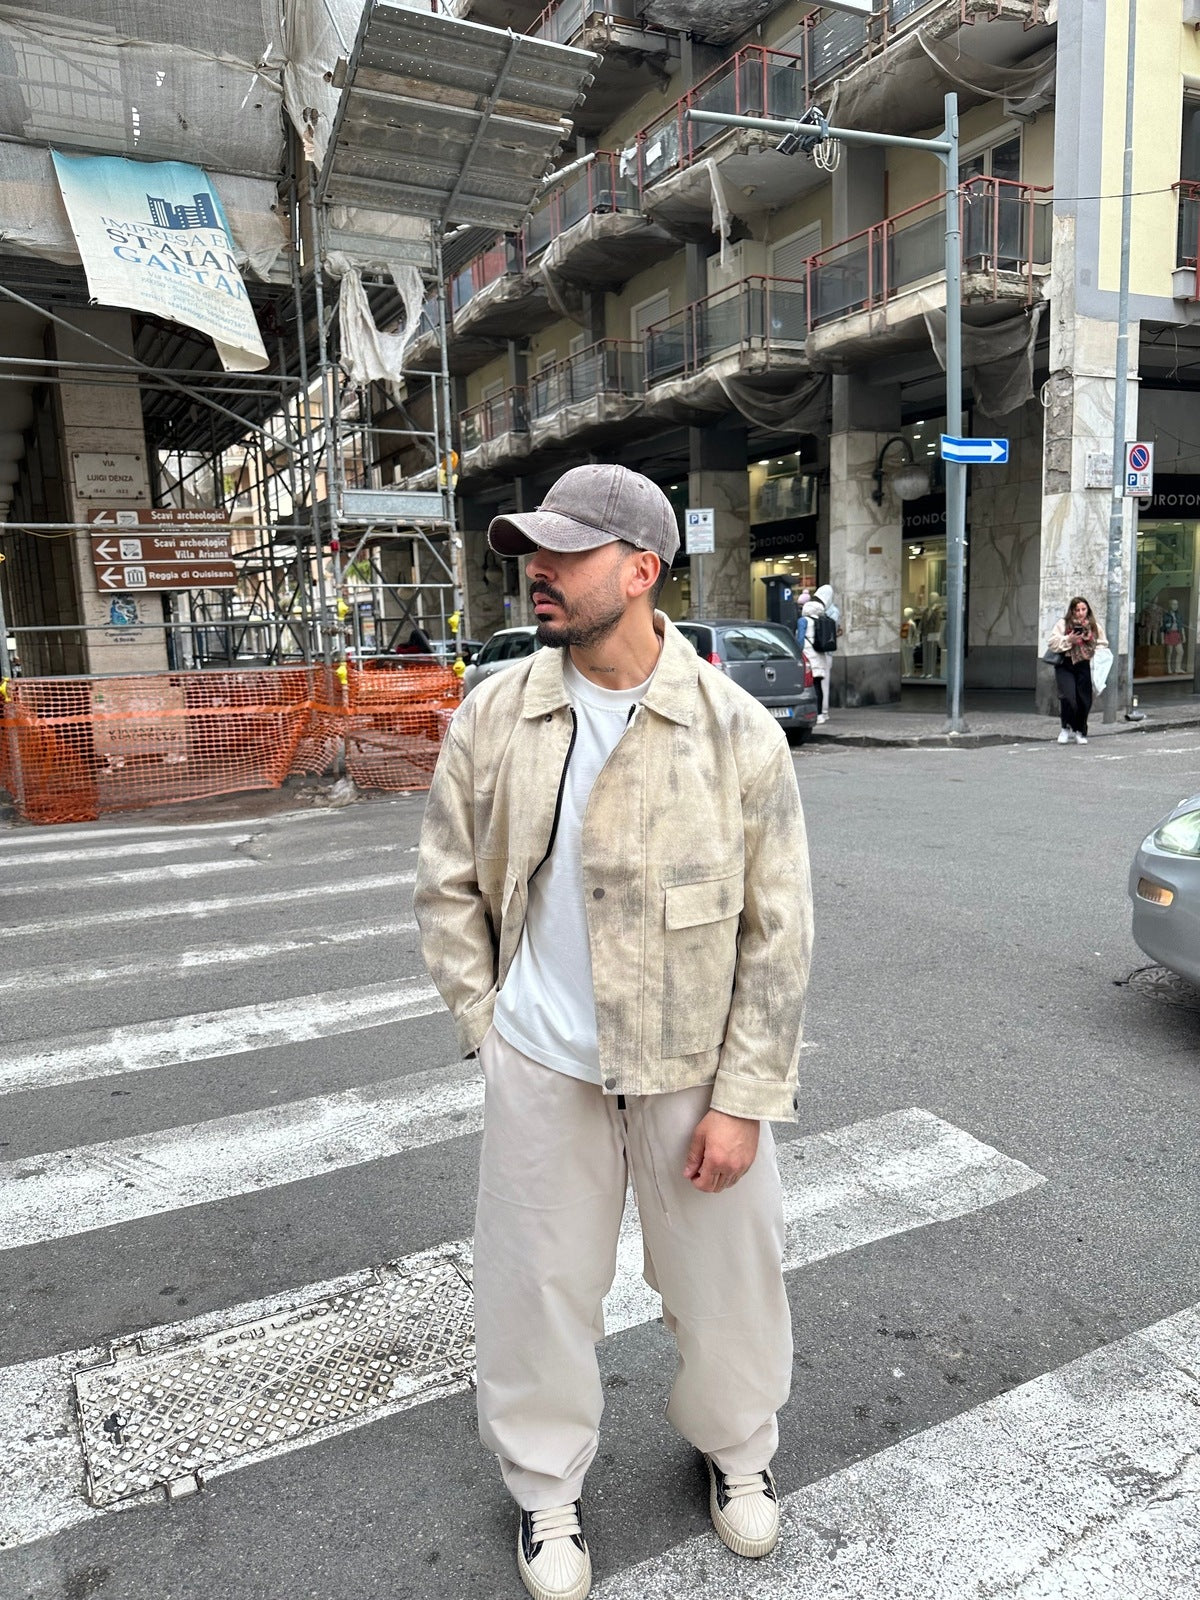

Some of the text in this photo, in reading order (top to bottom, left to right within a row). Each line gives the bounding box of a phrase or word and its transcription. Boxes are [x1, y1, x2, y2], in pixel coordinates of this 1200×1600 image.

[101, 216, 206, 247] IMPRESA
[87, 474, 134, 483] LUIGI DENZA
[151, 511, 226, 522] Scavi archeologici
[154, 538, 228, 549] Scavi archeologici
[175, 549, 229, 559] Villa Arianna
[149, 570, 234, 581] Reggia di Quisisana
[784, 588, 792, 601] P
[271, 1307, 329, 1330] open
